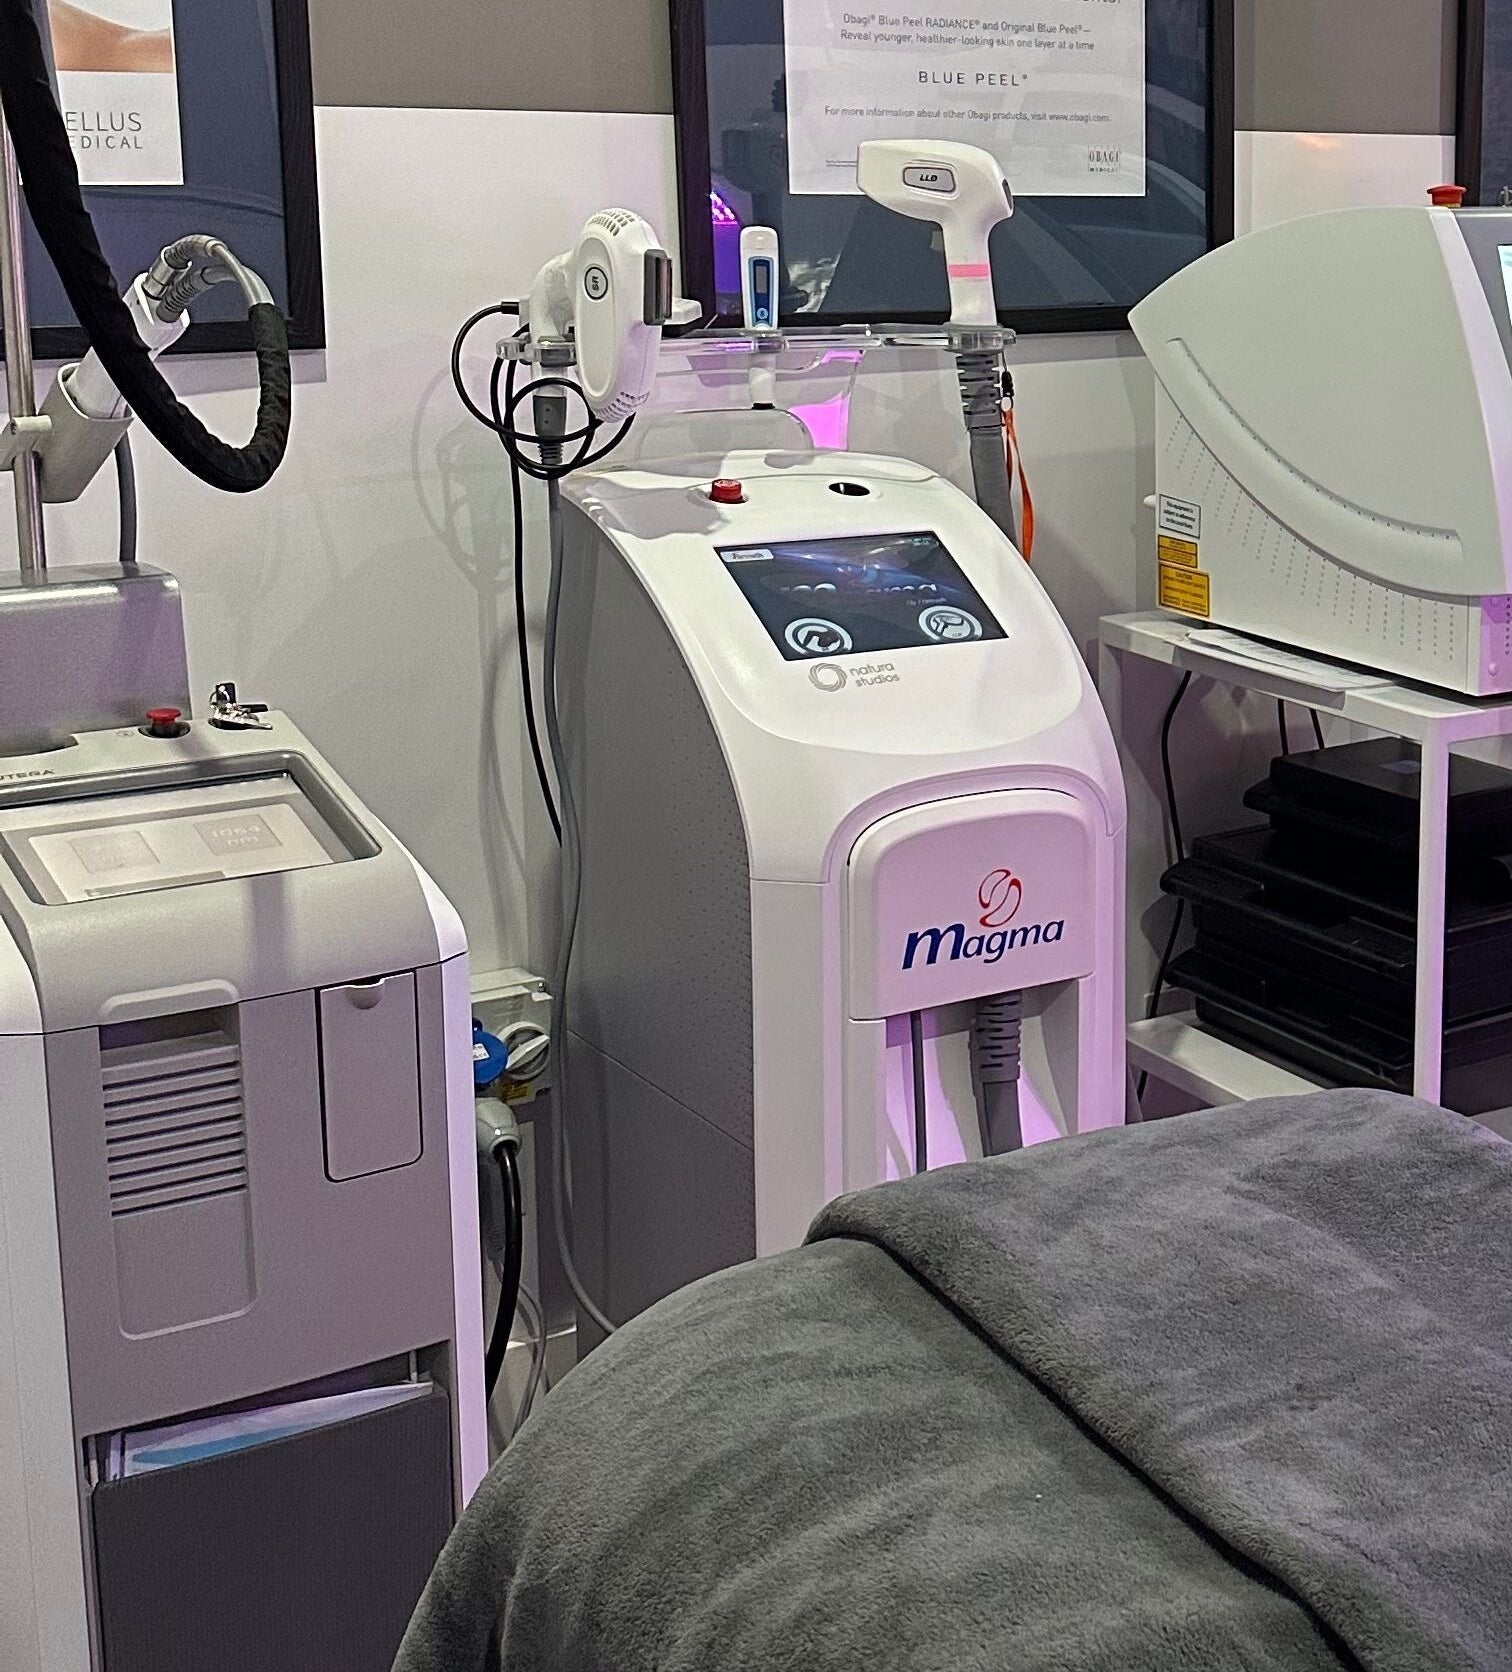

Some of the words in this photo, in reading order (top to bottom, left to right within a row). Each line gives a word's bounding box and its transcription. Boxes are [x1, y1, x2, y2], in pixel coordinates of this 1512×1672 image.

[879, 15, 900, 26] Blue
[903, 16, 923, 27] Peel
[983, 21, 999, 31] and
[1001, 21, 1035, 34] Original
[1038, 23, 1057, 33] Blue
[841, 29, 872, 40] Reveal
[874, 33, 914, 44] younger,
[916, 33, 994, 48] healthier-looking
[996, 38, 1015, 48] skin
[1017, 40, 1032, 48] one
[1035, 39, 1056, 50] layer
[1058, 41, 1067, 49] at
[1076, 41, 1095, 50] time
[918, 71, 966, 84] BLUE
[825, 105, 840, 115] For
[841, 107, 864, 116] more
[866, 107, 914, 118] information
[917, 109, 941, 118] about
[943, 110, 966, 119] other
[967, 110, 991, 121] Obagi
[1031, 112, 1047, 120] visit
[65, 112, 142, 132] ELLUS
[1089, 151, 1119, 163] OBAGI
[849, 663, 895, 676] natura
[855, 674, 900, 687] studios
